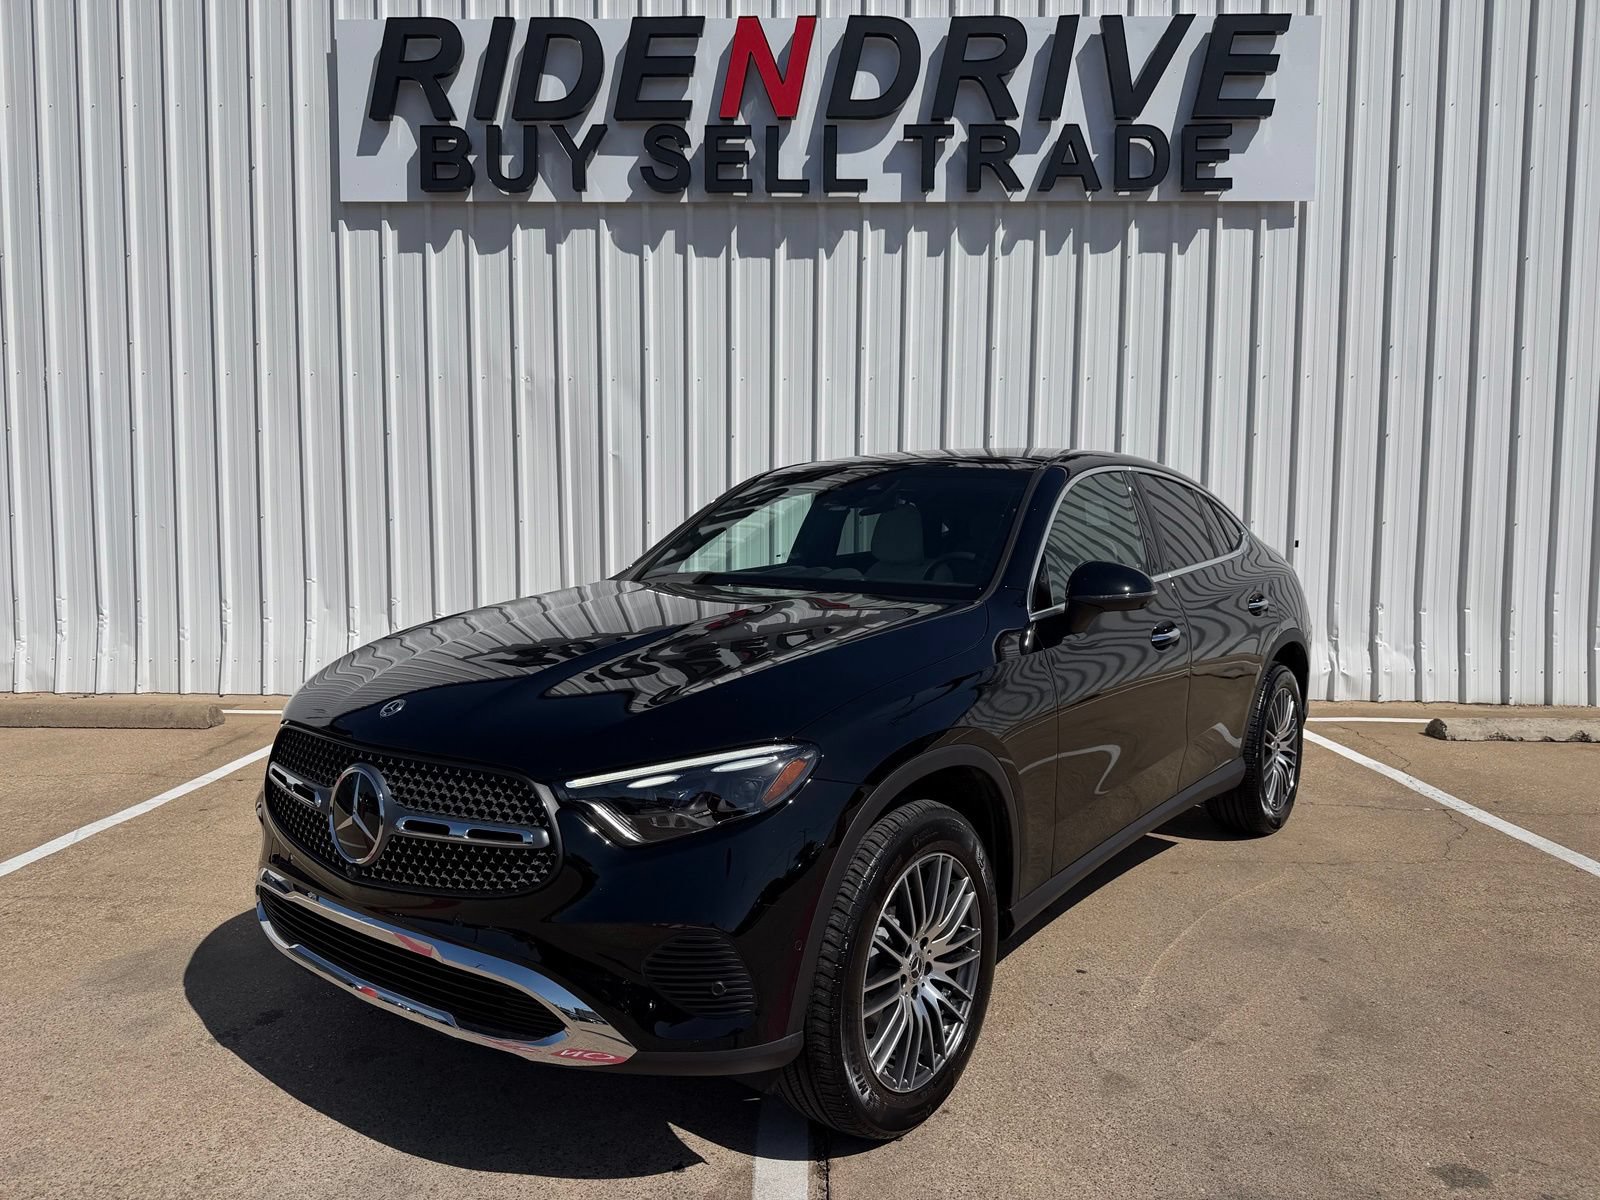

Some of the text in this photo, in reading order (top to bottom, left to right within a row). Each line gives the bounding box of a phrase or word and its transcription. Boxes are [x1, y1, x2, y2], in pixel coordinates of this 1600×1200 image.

[368, 13, 1292, 121] RIDENDRIVE
[420, 123, 1233, 194] BUY SELL TRADE
